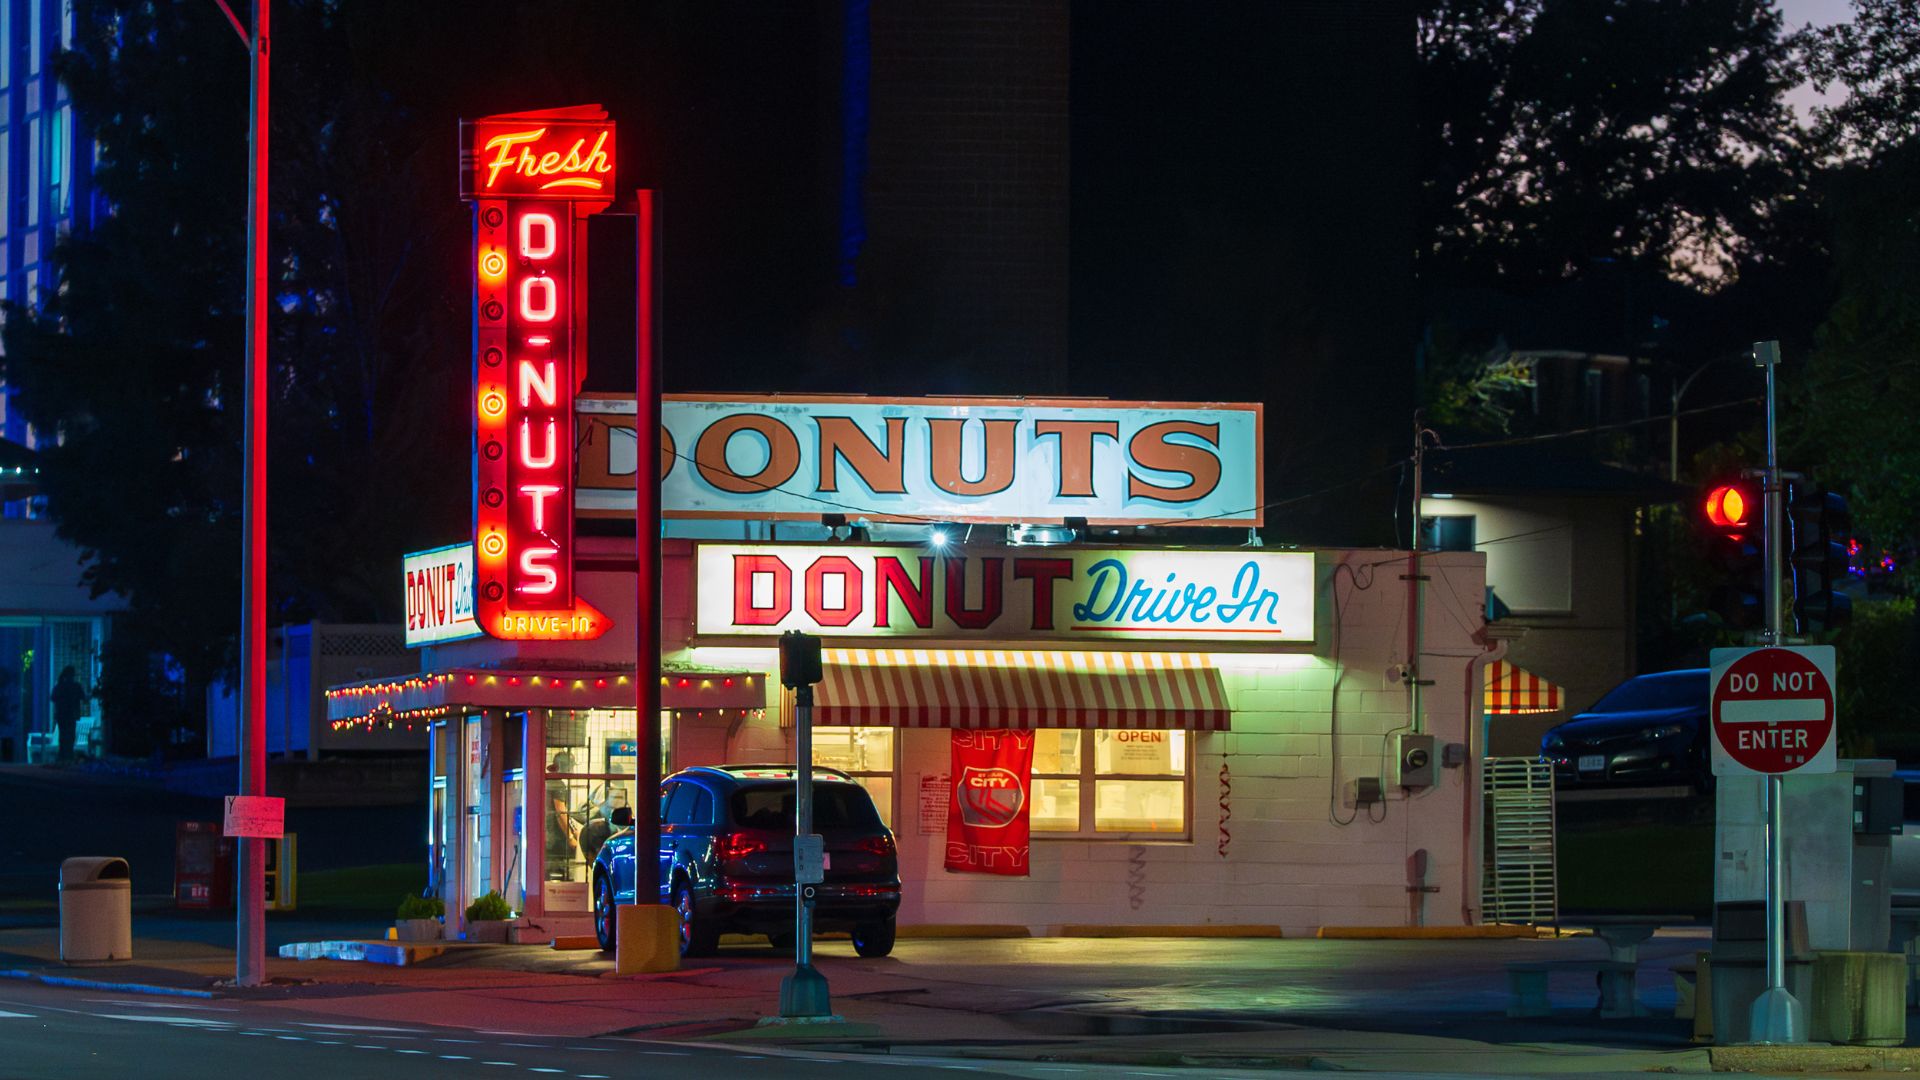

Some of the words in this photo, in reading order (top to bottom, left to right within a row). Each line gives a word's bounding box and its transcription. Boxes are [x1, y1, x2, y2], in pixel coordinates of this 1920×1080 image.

[485, 128, 612, 188] Fresh
[575, 412, 1222, 503] DONUTS
[407, 563, 456, 631] DONUT
[732, 554, 1074, 631] DONUT
[1074, 558, 1216, 623] Drive
[1216, 560, 1282, 625] In
[1730, 673, 1759, 692] DO
[1772, 672, 1816, 692] NOT
[952, 729, 1035, 750] CITY
[1117, 731, 1162, 743] OPEN
[1738, 729, 1808, 749] ENTER
[970, 777, 1009, 787] CITY
[945, 843, 1029, 867] CITY
